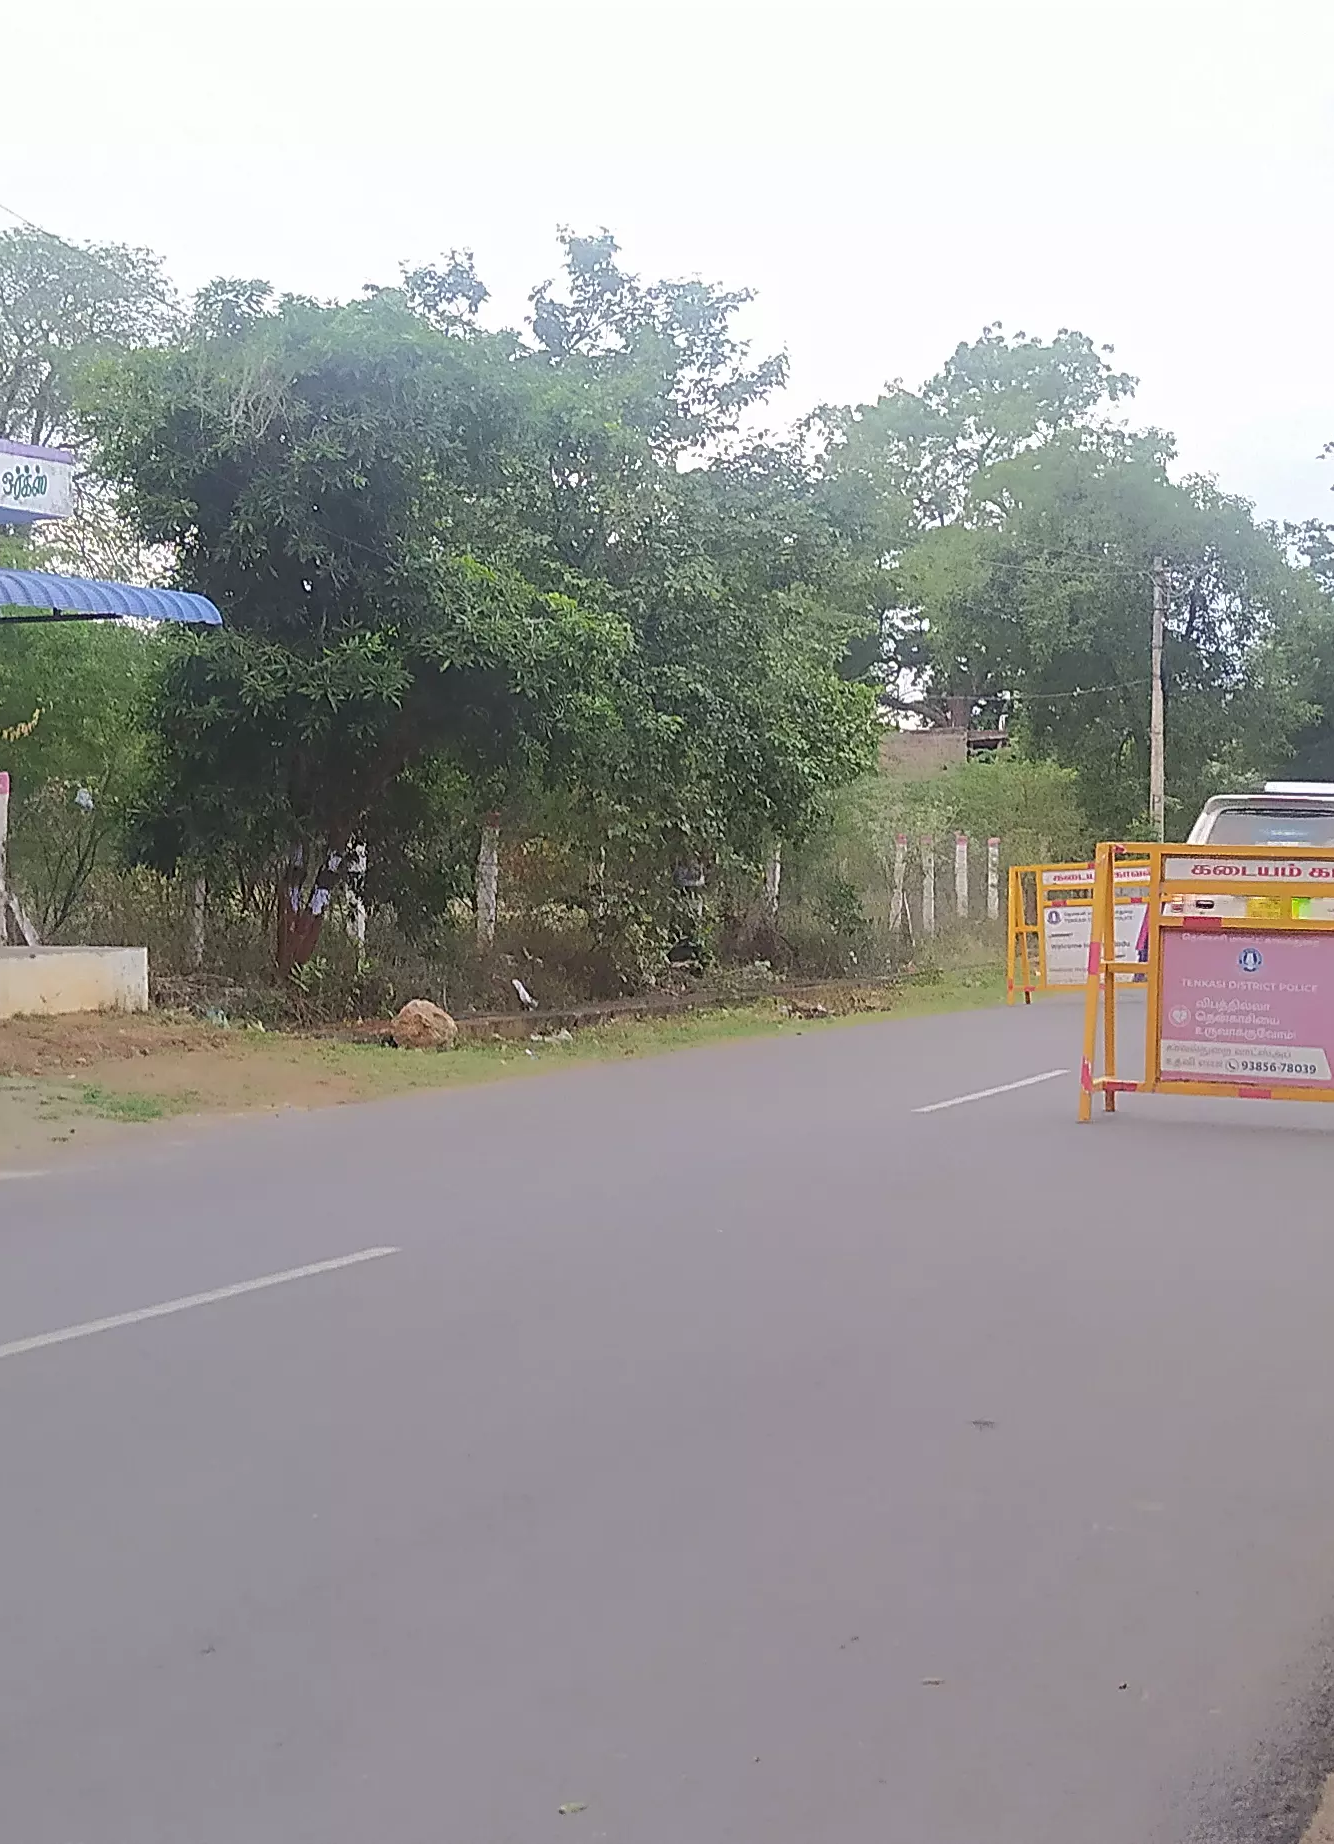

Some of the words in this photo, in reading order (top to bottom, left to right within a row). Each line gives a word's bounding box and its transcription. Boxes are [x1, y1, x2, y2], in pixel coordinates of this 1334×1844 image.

[1190, 863, 1303, 878] கடையம்
[1182, 978, 1227, 989] TENKASI
[1228, 980, 1276, 991] DISTRICT
[1279, 982, 1319, 993] POLICE
